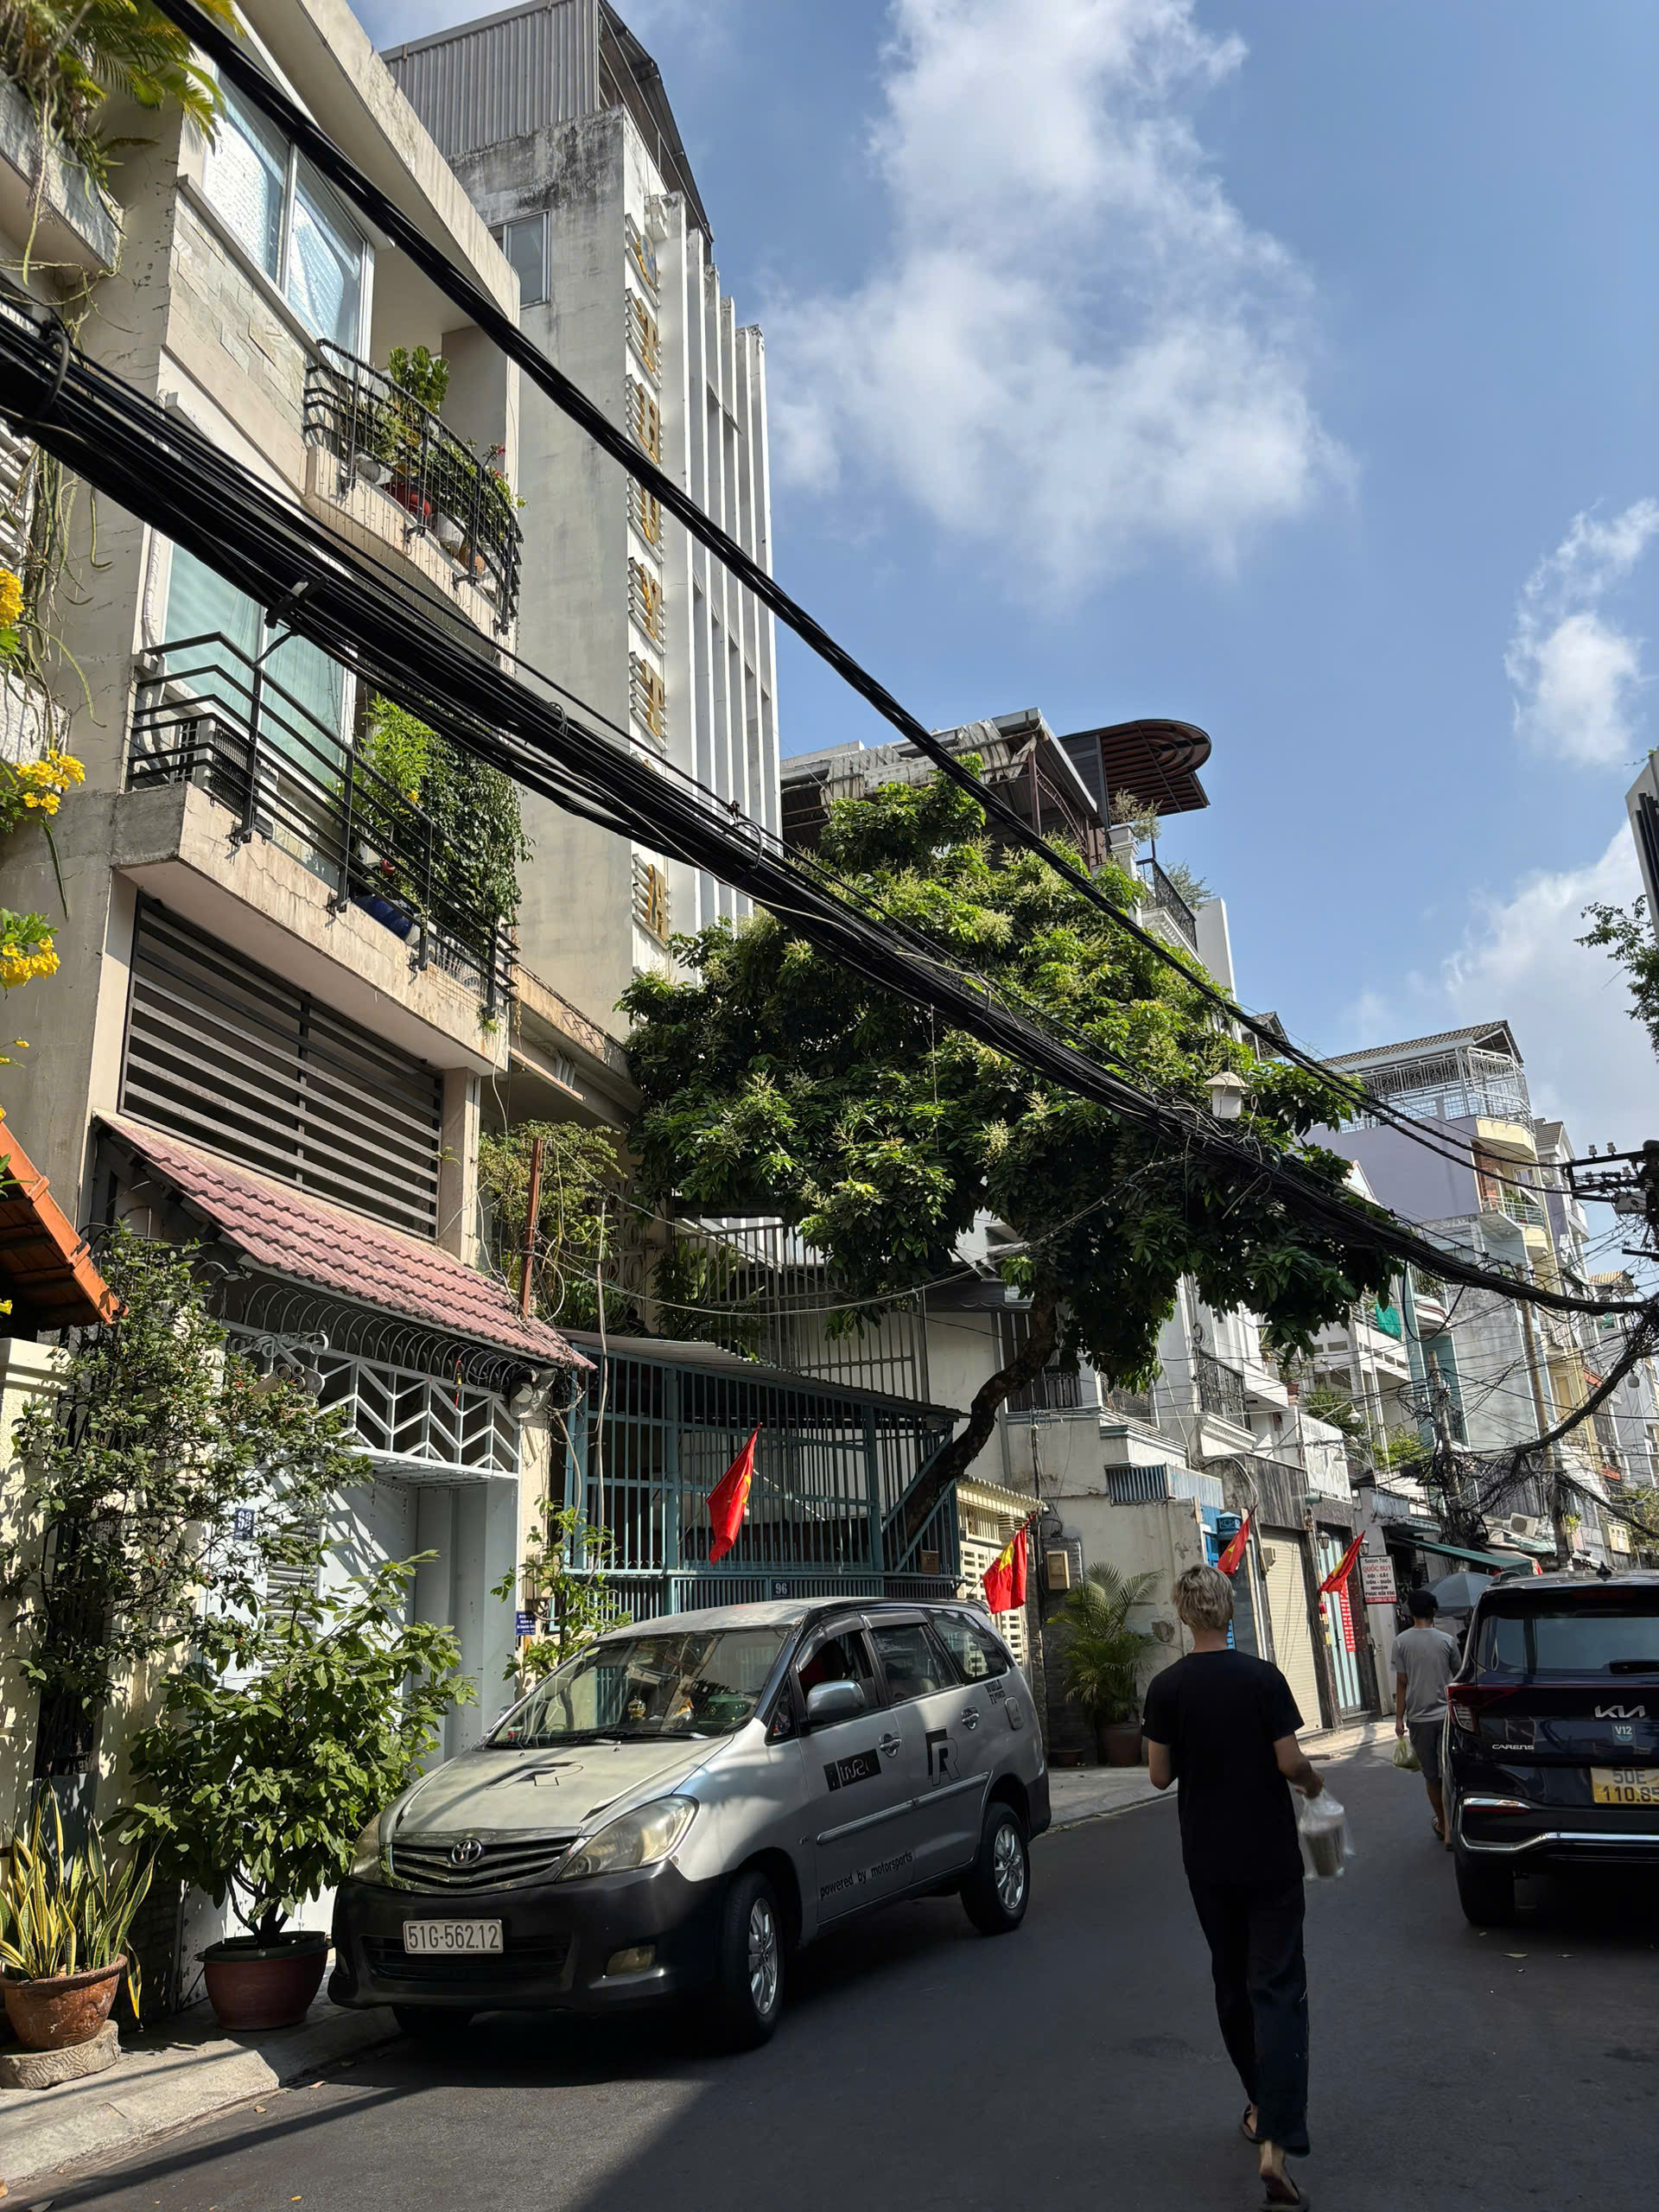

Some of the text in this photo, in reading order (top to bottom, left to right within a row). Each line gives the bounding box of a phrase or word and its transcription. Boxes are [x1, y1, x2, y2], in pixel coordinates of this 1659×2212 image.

[775, 1582, 787, 1595] 96
[1614, 1726, 1632, 1736] V12
[1612, 1769, 1647, 1784] 50E
[820, 1851, 914, 1901] powered by motorsports
[408, 1924, 499, 1949] 51G-562.12
